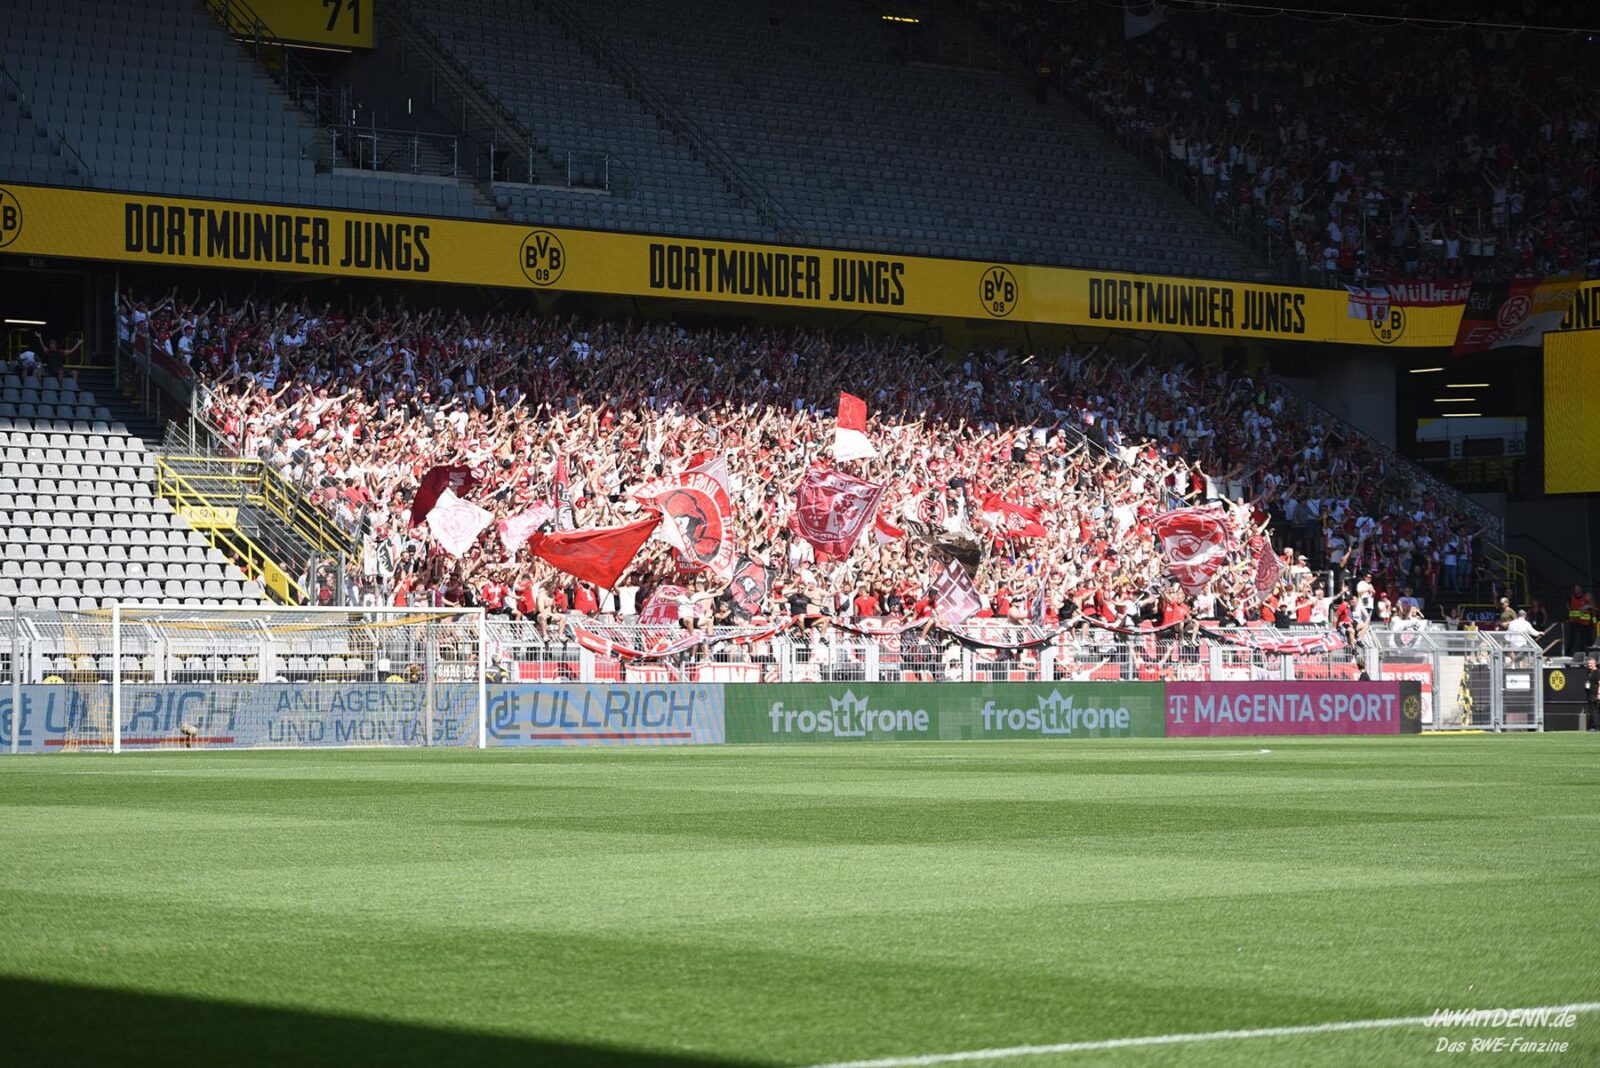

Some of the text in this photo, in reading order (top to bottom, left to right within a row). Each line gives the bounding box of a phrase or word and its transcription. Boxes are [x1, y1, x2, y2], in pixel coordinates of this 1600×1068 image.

[125, 203, 430, 272] DORTMUNDER JUNGS
[526, 235, 560, 270] BVB
[536, 269, 549, 281] 09
[650, 243, 904, 305] DORTMUNDER JUNGS
[985, 270, 1014, 302] BVB
[993, 301, 1005, 312] 09
[1089, 278, 1305, 333] DORTMUNDER JUNGS
[276, 690, 450, 713] ANLAGENBAU
[769, 698, 930, 733] frostkrone
[981, 698, 1130, 732] frostkrone
[1194, 694, 1314, 723] MAGENTA
[1319, 694, 1396, 723] SPORT
[268, 719, 458, 742] UND MONTAGE
